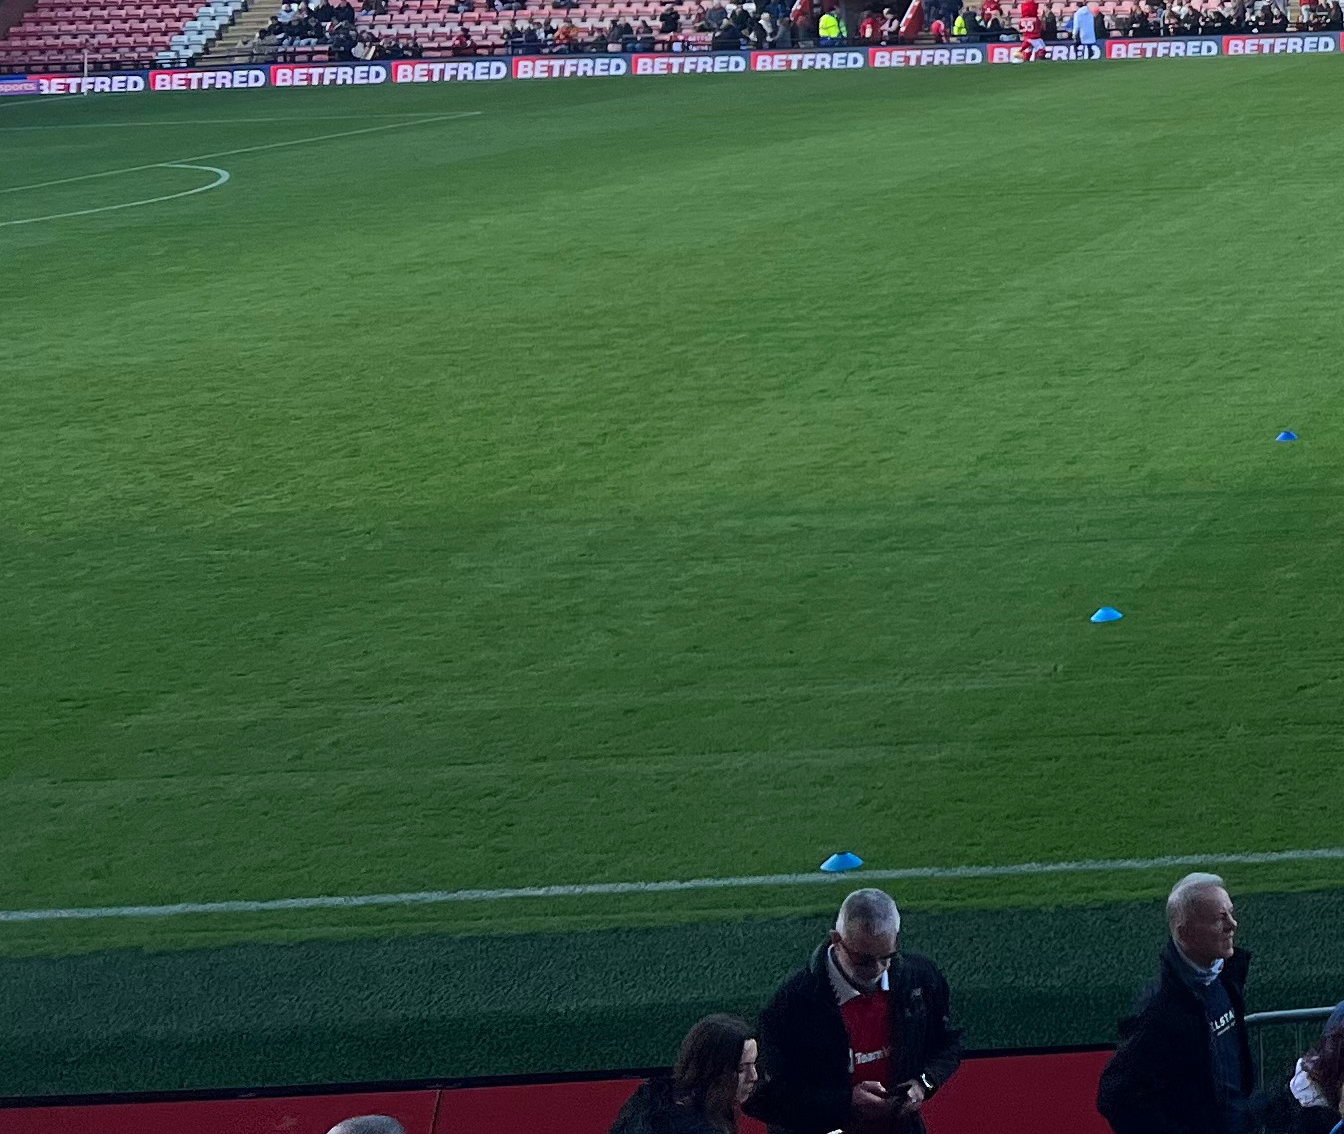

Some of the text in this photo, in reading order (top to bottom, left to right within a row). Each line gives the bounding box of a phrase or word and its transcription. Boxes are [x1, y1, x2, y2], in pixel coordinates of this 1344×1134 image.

[1111, 40, 1218, 58] BETFRED
[1229, 36, 1335, 54] BETFRED
[638, 56, 745, 74] BETFRED
[756, 52, 863, 71] BETFRED
[874, 48, 982, 67] BETFRED
[276, 65, 387, 87] BETFRED
[397, 62, 507, 83] BETFRED
[519, 58, 626, 78] BETFRED
[155, 69, 266, 90] BETFRED
